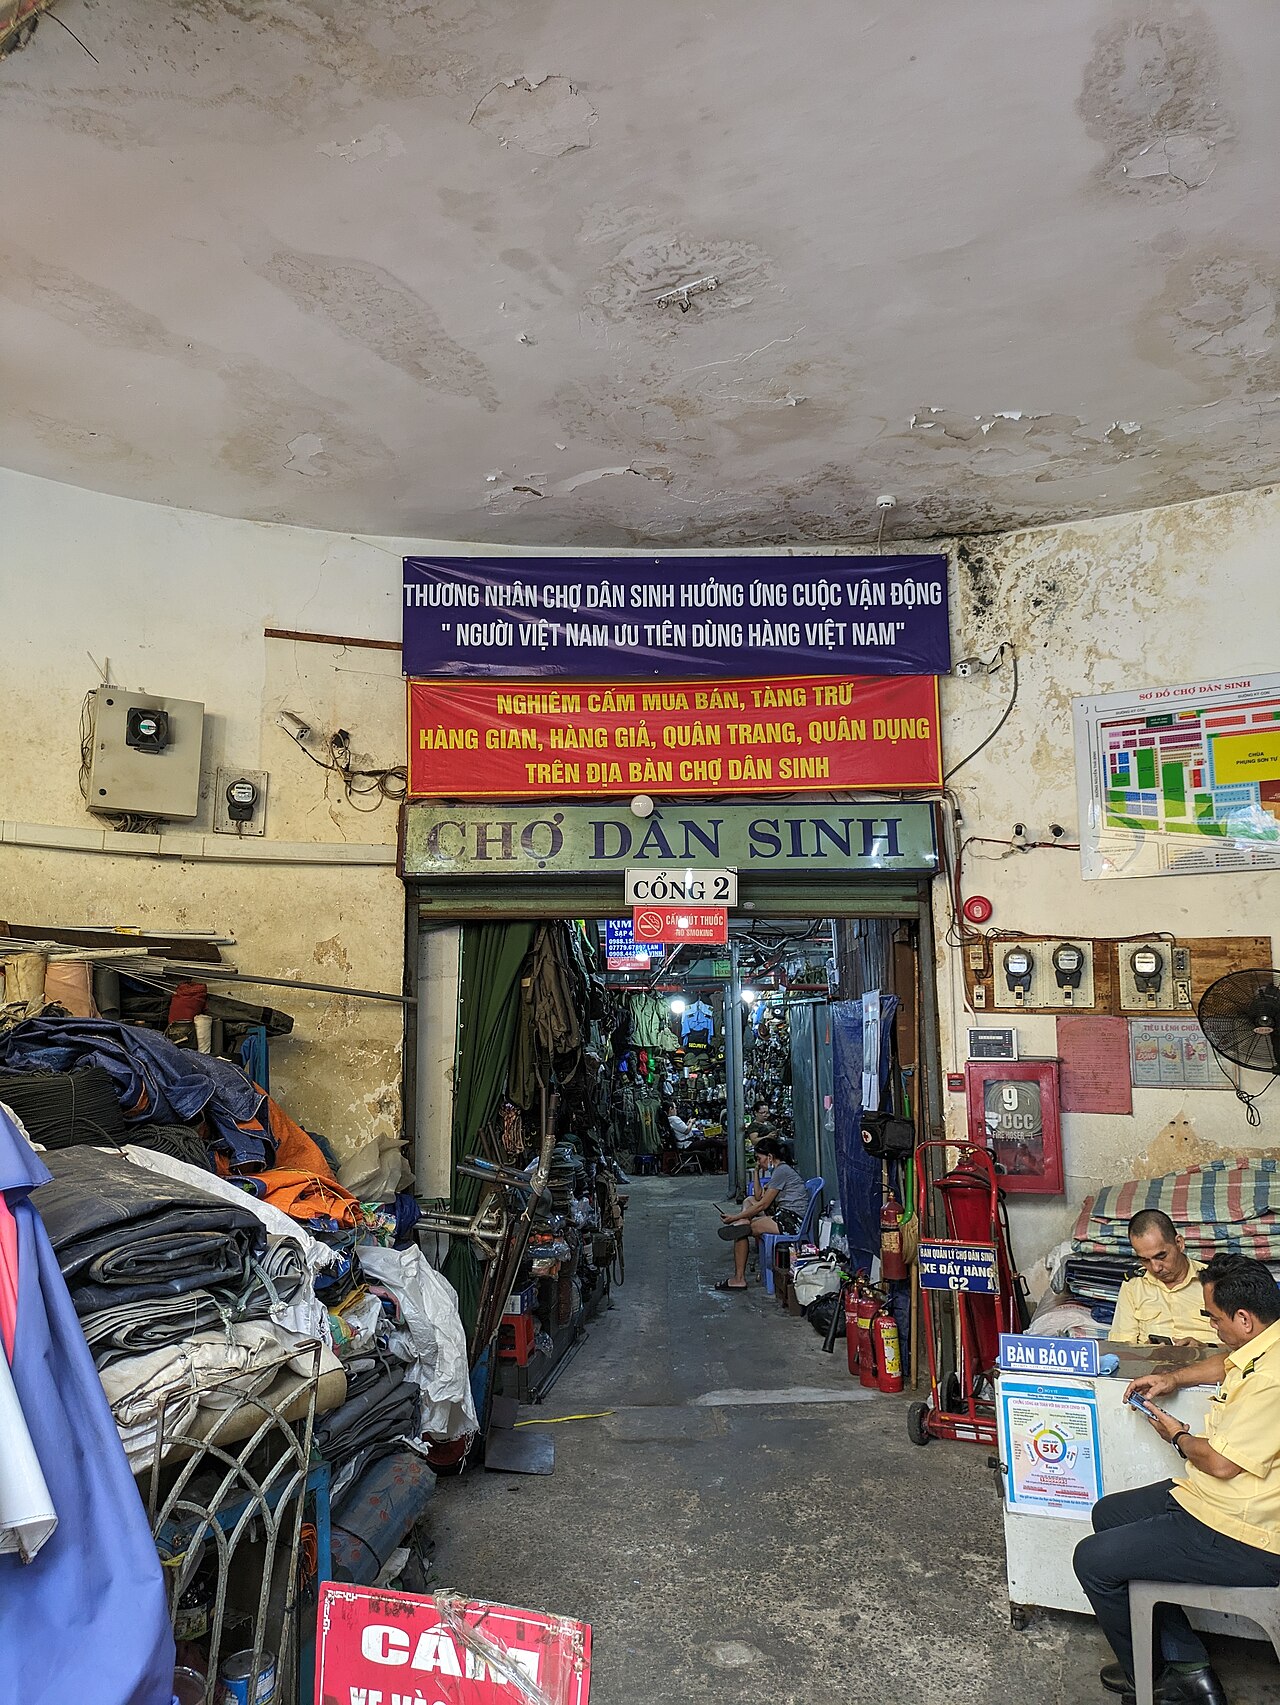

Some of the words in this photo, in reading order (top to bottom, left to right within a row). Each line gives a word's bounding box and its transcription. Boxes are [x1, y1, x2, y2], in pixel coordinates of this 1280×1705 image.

[403, 583, 479, 607] THƯƠNG
[485, 580, 537, 607] NHÂN
[543, 584, 581, 612] CHỢ
[587, 580, 625, 607] DÂN
[630, 584, 674, 607] SINH
[680, 577, 743, 607] HƯỞNG
[749, 579, 786, 606] ỨNG
[792, 579, 841, 610] CUỘC
[847, 579, 886, 610] VẬN
[890, 578, 942, 609] ĐỘNG
[457, 619, 513, 646] NGƯỜI
[519, 619, 560, 650] VIỆT
[566, 623, 608, 647] NAM
[614, 622, 639, 647] ƯU
[644, 620, 686, 647] TIÊN
[692, 620, 743, 647] DÙNG
[748, 619, 800, 647] HÀNG
[805, 619, 847, 650] VIỆT
[852, 622, 904, 646] NAM"
[497, 691, 580, 714] NGHIÊM
[588, 688, 638, 713] CẤM
[643, 693, 688, 711] MUA
[695, 688, 745, 711] BÁN,
[751, 686, 806, 707] TÀNG
[813, 682, 854, 705] TRỮ
[1139, 692, 1152, 700] SƠ
[1173, 687, 1196, 697] CHỢ
[1200, 684, 1221, 693] DÂN
[1224, 681, 1251, 689] SINH
[419, 725, 478, 750] HÀNG
[486, 728, 543, 751] GIAN,
[550, 723, 608, 749] HÀNG
[615, 720, 656, 749] GIẢ,
[663, 721, 720, 748] QUÂN
[727, 722, 802, 745] TRANG,
[808, 716, 866, 743] QUÂN
[873, 718, 930, 744] DỤNG
[525, 759, 579, 783] TRÊN
[586, 762, 622, 787] ĐỊA
[629, 758, 672, 782] BÀN
[679, 758, 721, 785] CHỢ
[728, 755, 772, 780] DÂN
[779, 757, 829, 779] SINH
[428, 812, 564, 870] CHỢ
[589, 811, 723, 860] DÂN
[748, 817, 903, 859] SINH
[633, 872, 706, 900] CỔNG
[713, 876, 729, 899] 2
[609, 920, 632, 930] KIM
[700, 913, 724, 926] THUỐC
[686, 929, 714, 937] SMOKING
[1003, 1086, 1018, 1111] 9
[920, 1248, 931, 1258] BAN
[932, 1247, 947, 1259] QUẢN
[948, 1249, 955, 1259] LÝ
[969, 1250, 980, 1261] DÂN
[922, 1262, 937, 1273] XE
[939, 1261, 960, 1275] ĐẨY
[964, 1264, 994, 1278] HÀNG
[948, 1276, 969, 1290] C2
[1007, 1342, 1035, 1363] BÀN
[1039, 1343, 1068, 1366] BẢO
[1072, 1347, 1089, 1371] VỆ
[1043, 1444, 1058, 1454] 5K
